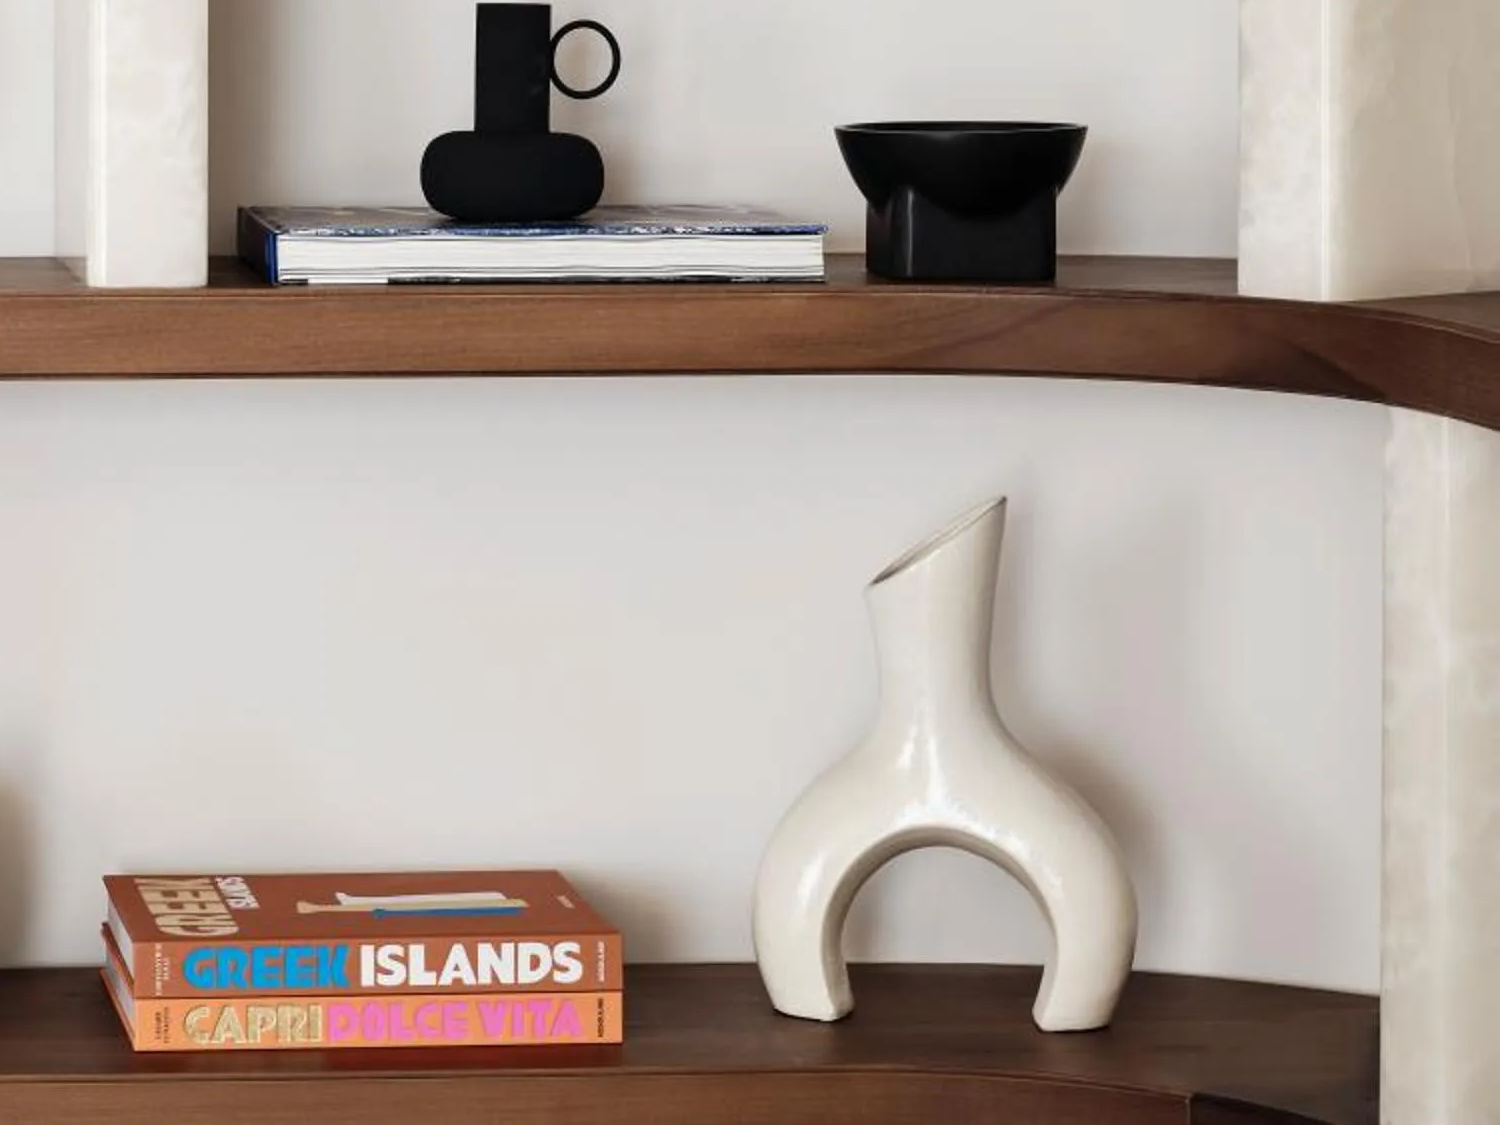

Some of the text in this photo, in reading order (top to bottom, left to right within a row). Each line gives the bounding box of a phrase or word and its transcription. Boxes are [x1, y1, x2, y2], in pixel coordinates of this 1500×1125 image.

[182, 944, 351, 989] GREEK
[360, 941, 584, 987] ISLANDS
[182, 1003, 323, 1044] CAPRI
[328, 1001, 474, 1041] DOLCE
[476, 998, 583, 1038] VITA
